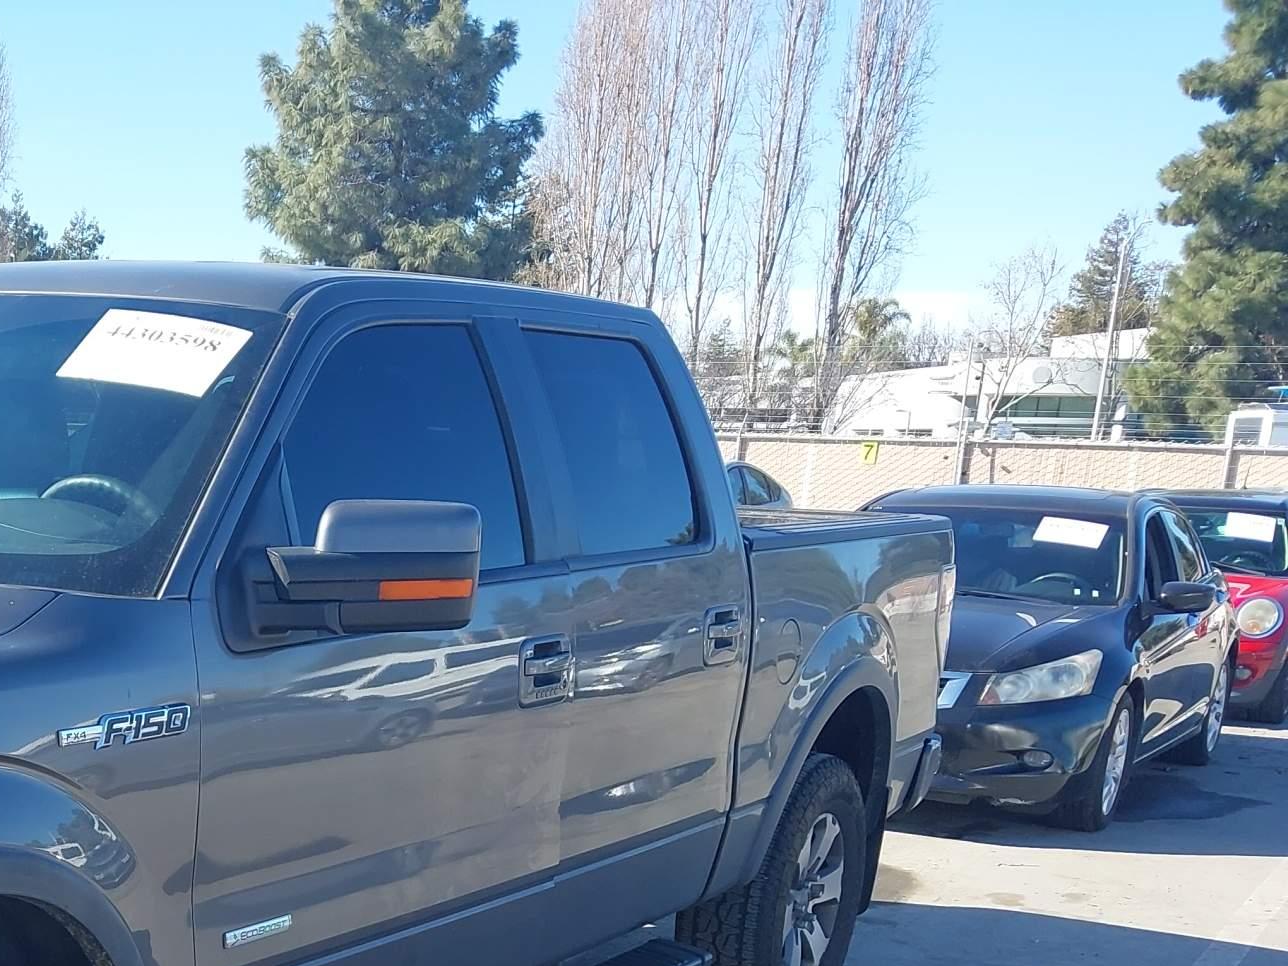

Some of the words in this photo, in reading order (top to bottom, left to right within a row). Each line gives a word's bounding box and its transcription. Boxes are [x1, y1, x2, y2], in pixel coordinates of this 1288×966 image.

[109, 326, 221, 351] 44303598
[864, 444, 874, 460] 7
[65, 730, 87, 743] FX4
[96, 705, 191, 749] F-150
